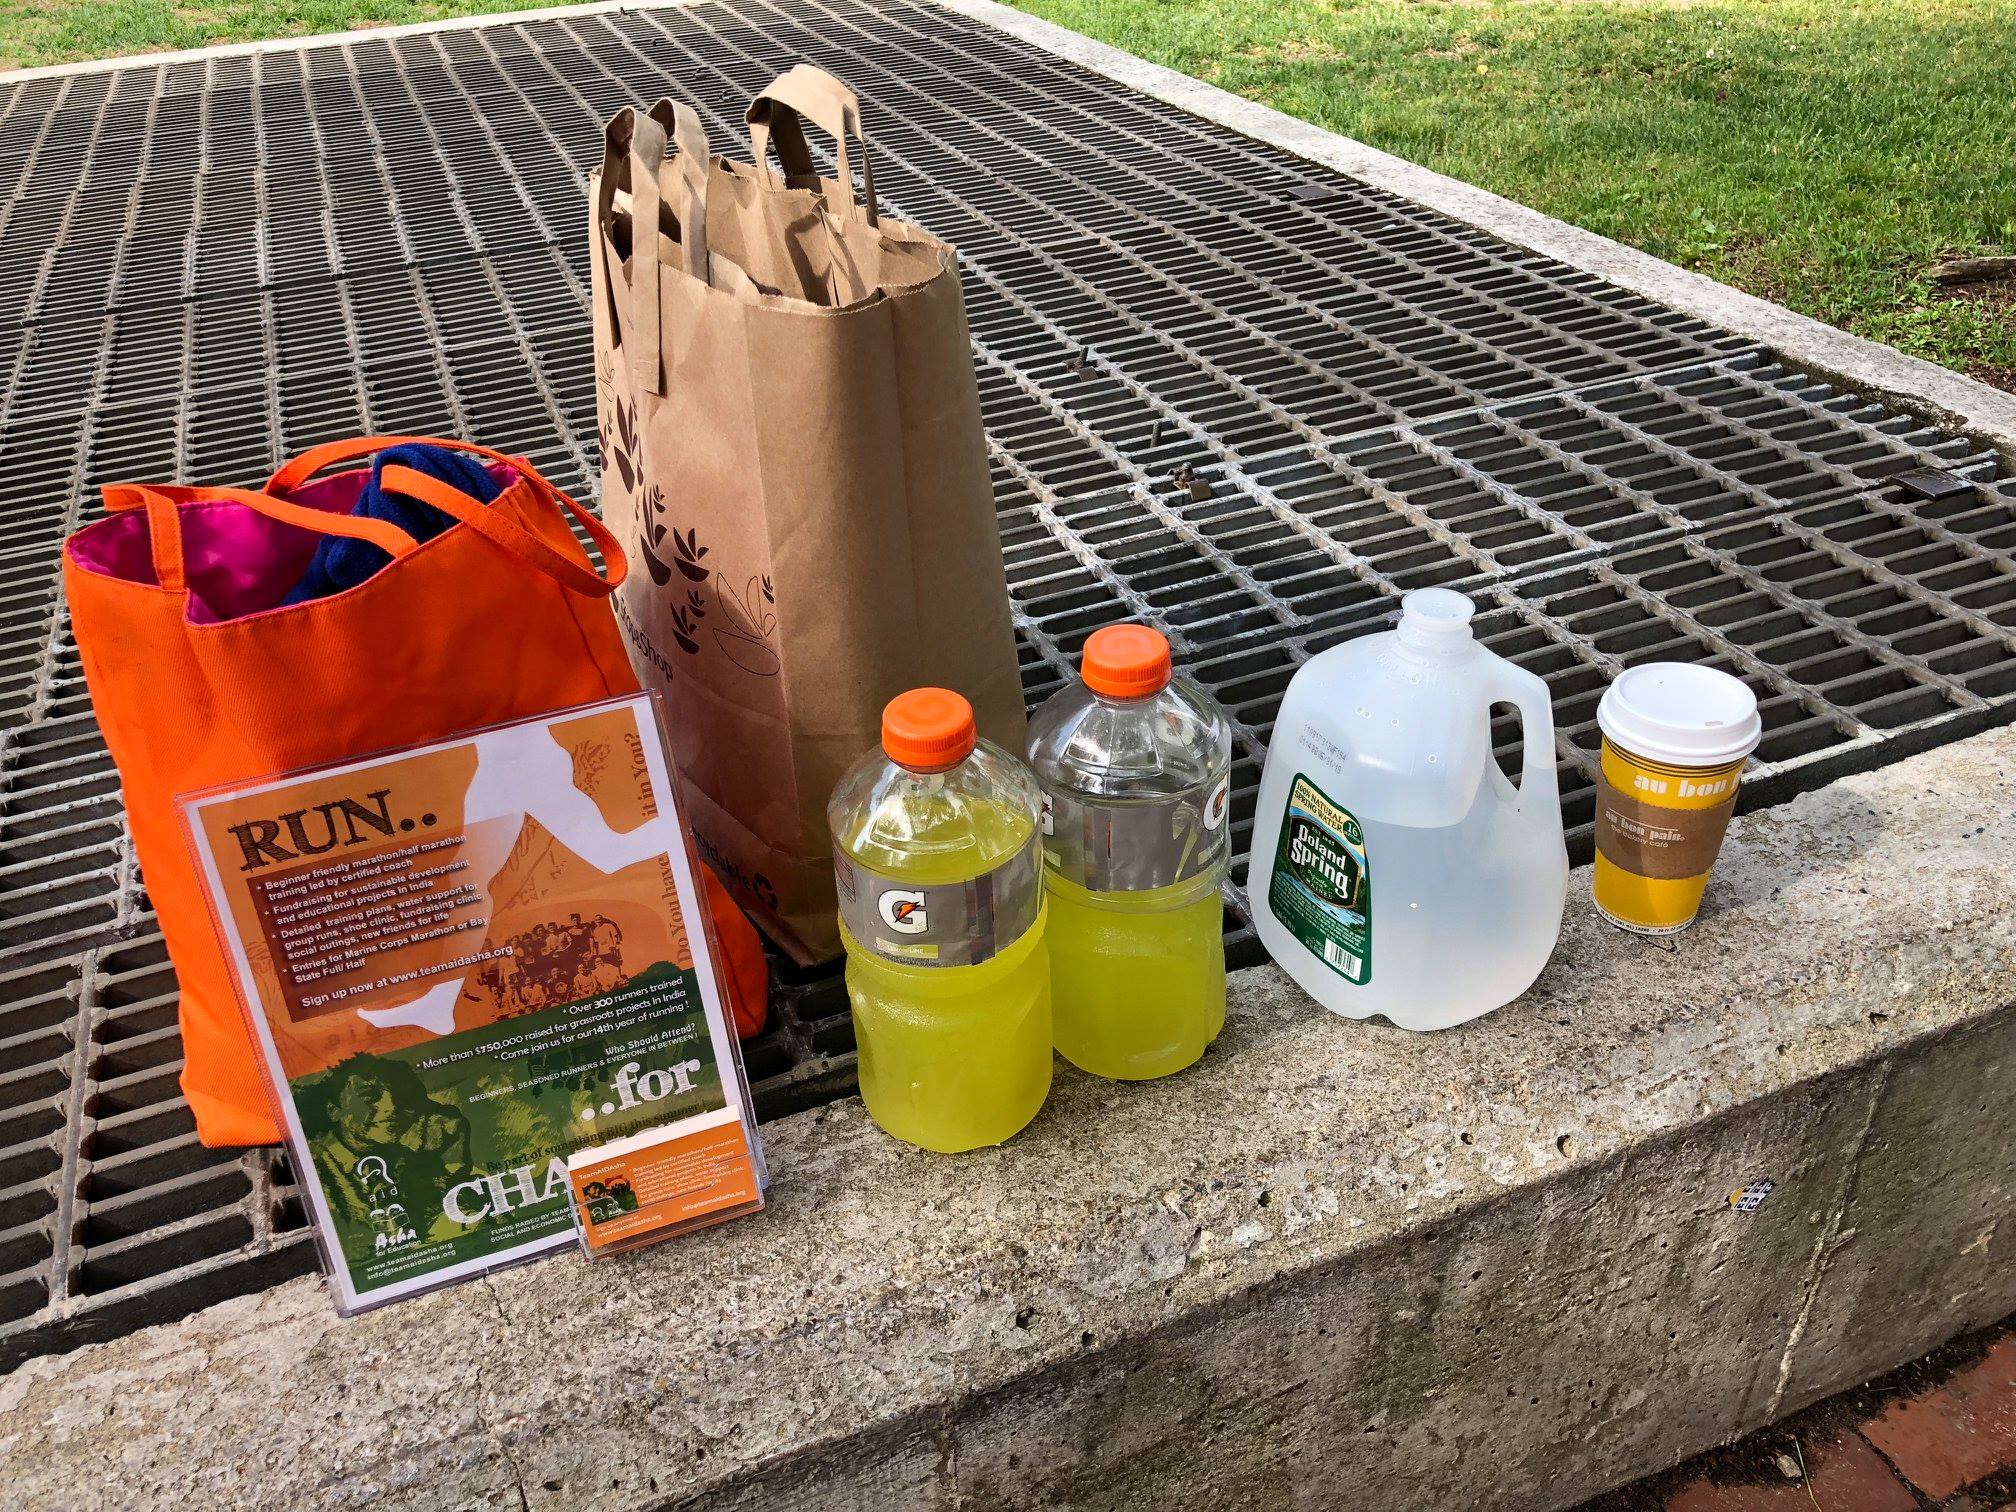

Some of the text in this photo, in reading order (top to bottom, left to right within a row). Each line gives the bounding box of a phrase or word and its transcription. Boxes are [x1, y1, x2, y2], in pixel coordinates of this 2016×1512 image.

[1297, 782, 1343, 825] 100% NATURAL
[1634, 775, 1667, 795] au
[1678, 780, 1726, 798] bon
[227, 788, 438, 870] RUN..
[1295, 790, 1343, 834] SPRING WATER
[1347, 823, 1358, 838] 16
[1621, 818, 1645, 836] bon
[265, 835, 466, 889] Beginner friendly marathon/half marathon
[624, 731, 693, 964] Do You have it in You?
[1290, 837, 1349, 899] Spring
[1298, 824, 1346, 872] Poland
[268, 858, 412, 900] training led by certified coach
[272, 858, 469, 913] Fundraising for sustainable development
[276, 913, 295, 924] and
[298, 898, 354, 919] educational
[356, 889, 396, 906] projects
[409, 880, 433, 891] India
[281, 883, 478, 938] Detailed training plans, water support for
[877, 890, 928, 934] G
[285, 936, 314, 950] group
[316, 930, 342, 940] runs,
[343, 923, 368, 933] shoe
[369, 915, 398, 926] clinic,
[399, 901, 454, 919] fundraising
[287, 945, 317, 959] social
[319, 937, 359, 951] outings,
[361, 931, 381, 940] new
[382, 921, 416, 934] friends
[433, 913, 449, 921] life
[291, 959, 326, 972] Entries
[344, 946, 377, 958] Marine
[379, 938, 408, 949] Corps
[410, 926, 455, 941] Marathon
[469, 917, 488, 926] Bay
[294, 971, 320, 983] State
[345, 958, 366, 969] Half
[301, 946, 514, 1006] Sign up now at www.teamaidasha.org
[568, 975, 683, 1014] Over 300 runners trained
[422, 989, 686, 1068] More than $750,000 raised for grassroots projects in India
[500, 1047, 529, 1060] Come
[530, 1041, 548, 1054] join
[549, 1038, 560, 1046] us
[561, 1034, 575, 1043] for
[615, 1017, 635, 1030] year
[637, 1011, 648, 1021] of
[648, 1003, 684, 1018] running
[605, 1022, 696, 1055] Who Should Attend?
[468, 1084, 516, 1102] BEGINNERS,
[517, 1071, 560, 1088] SEASONED
[560, 1060, 598, 1076] RUNNERS
[606, 1046, 646, 1063] EVERYONE
[648, 1043, 656, 1051] IN
[657, 1033, 693, 1048] BETWEEN
[581, 1057, 701, 1120] ..for
[485, 1161, 499, 1171] Be
[503, 1151, 528, 1169] part
[530, 1147, 543, 1158] of
[544, 1132, 604, 1154] something
[605, 1122, 627, 1136] BIG
[631, 1117, 652, 1129] this
[368, 1186, 398, 1202] aid
[374, 1226, 417, 1250] Asha
[490, 1224, 513, 1235] FUNDS
[514, 1215, 539, 1227] RAISED
[550, 1205, 571, 1216] TEAM
[490, 1230, 514, 1242] SOCIAL
[515, 1225, 531, 1234] AND
[531, 1214, 566, 1229] ECONOMIC
[366, 1243, 454, 1271] www.teamaidasha.org
[367, 1250, 457, 1280] info@teamaidasha.org
[387, 1240, 421, 1253] Education
